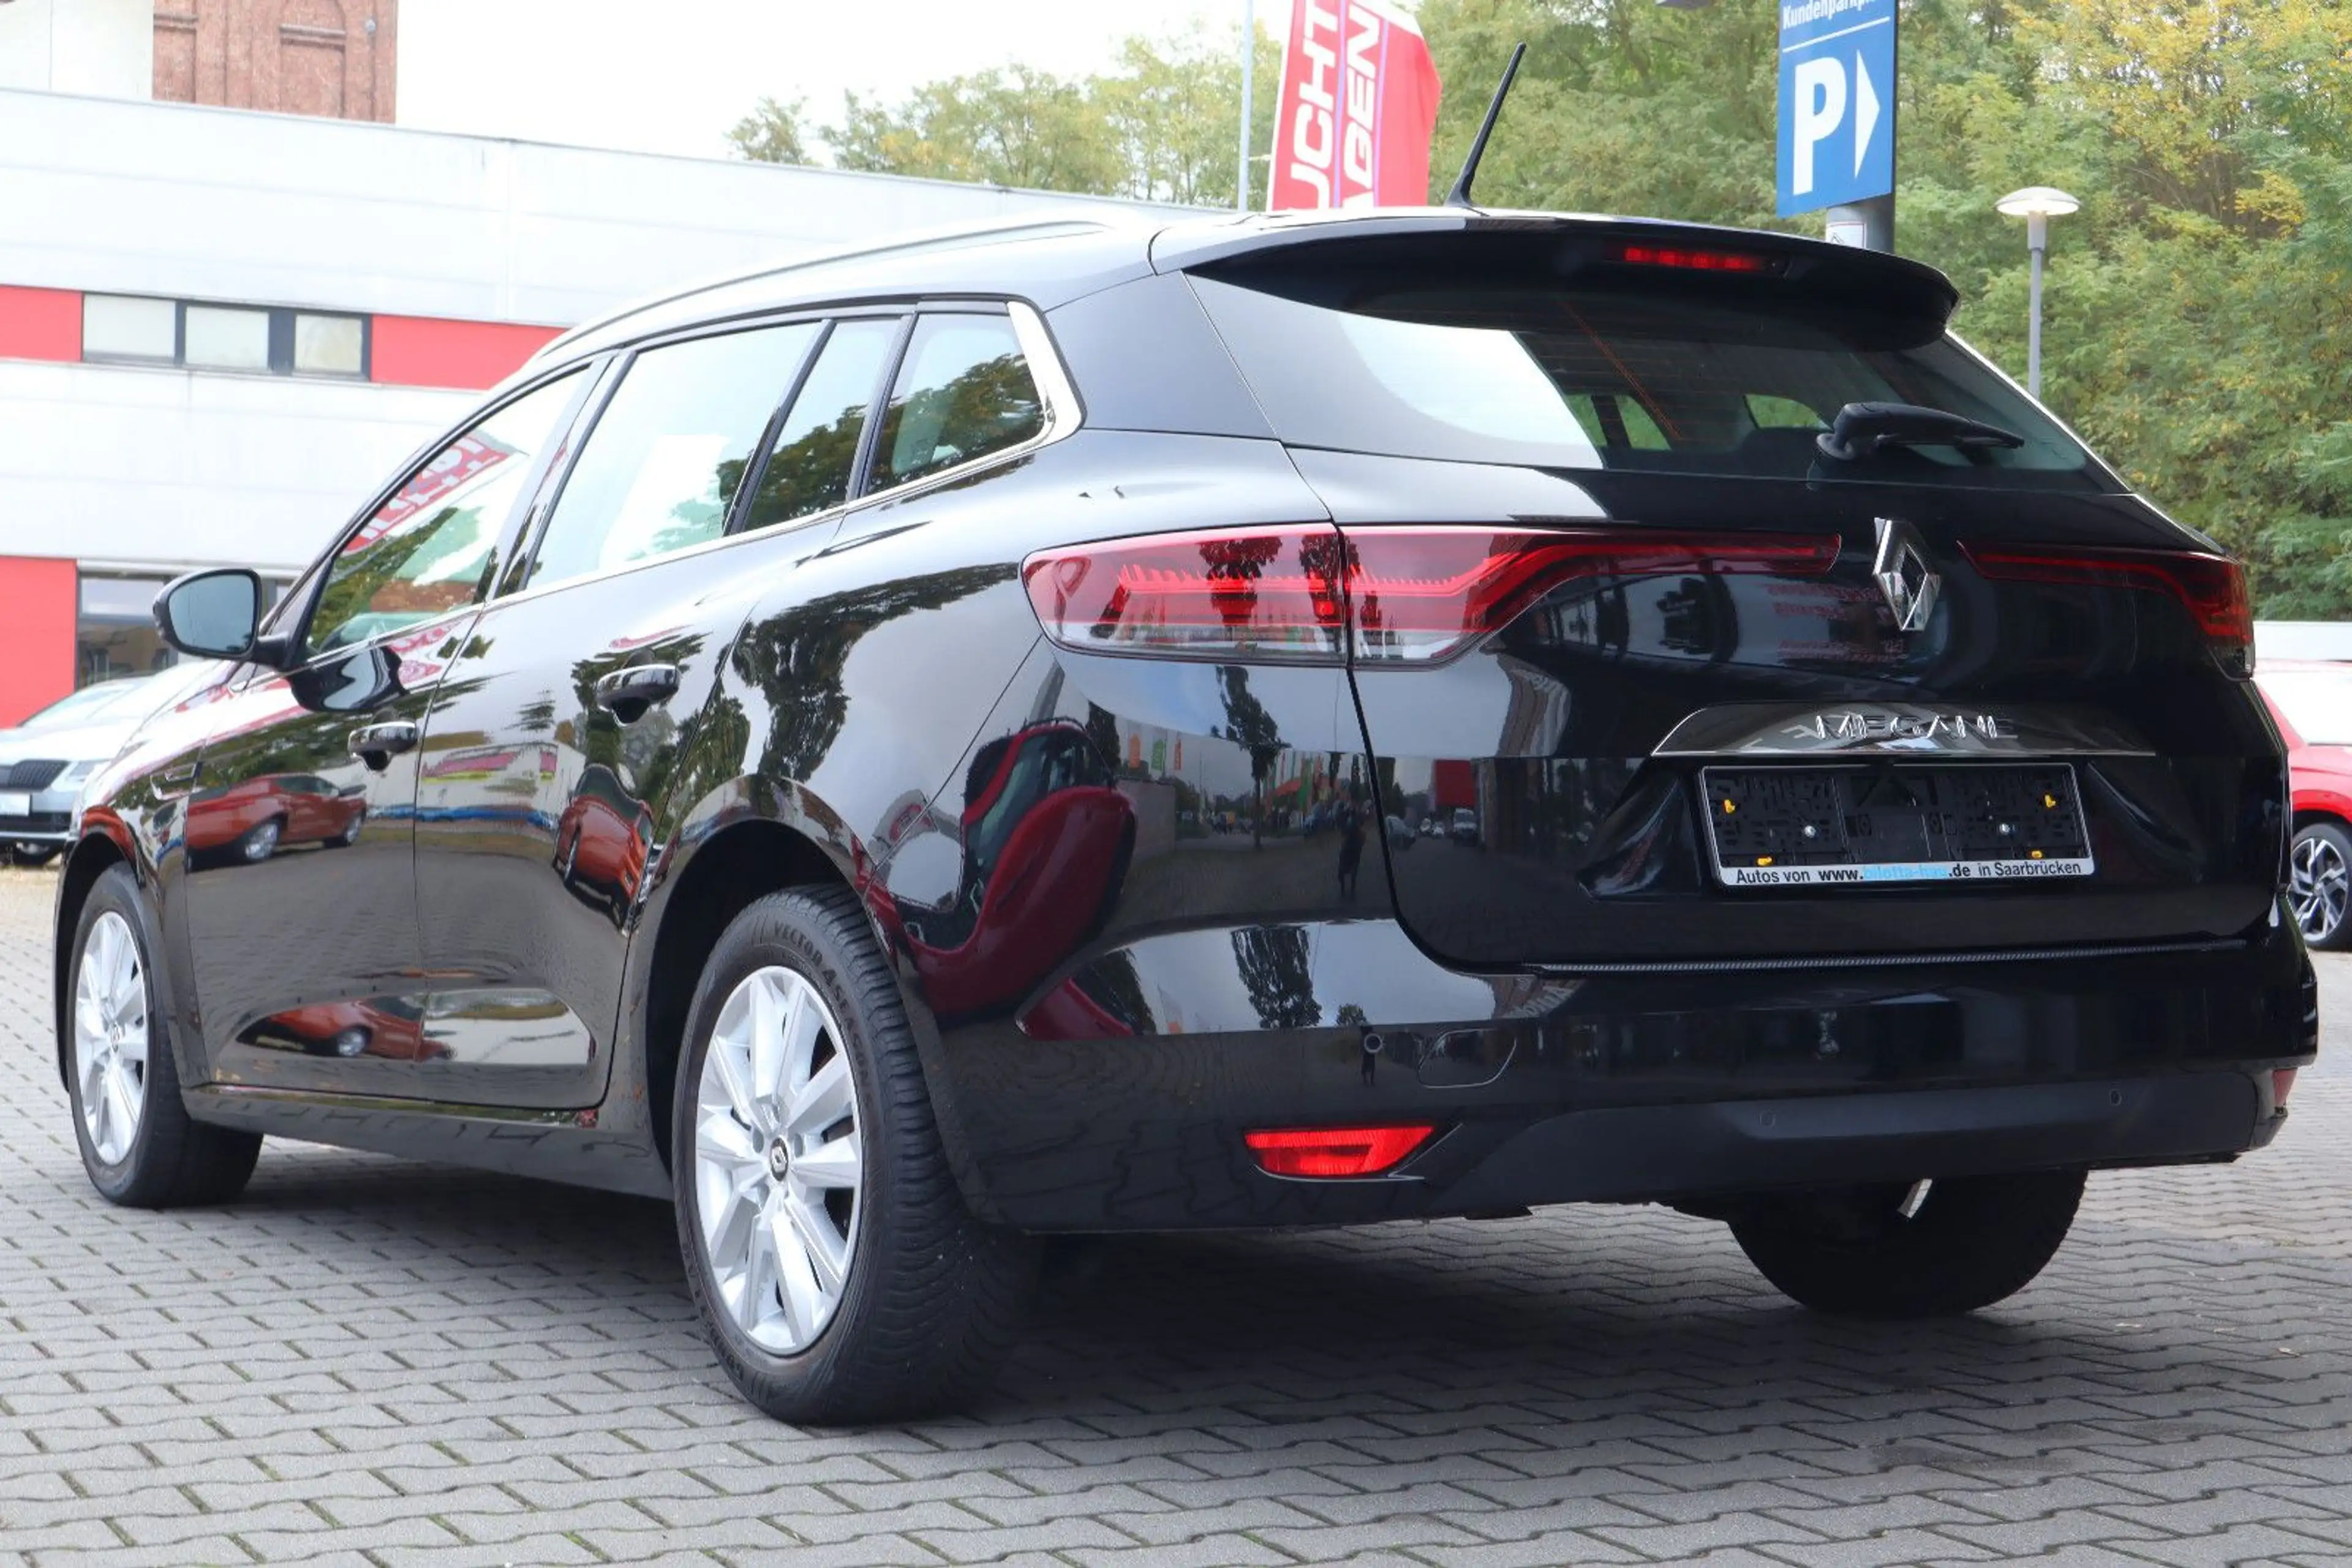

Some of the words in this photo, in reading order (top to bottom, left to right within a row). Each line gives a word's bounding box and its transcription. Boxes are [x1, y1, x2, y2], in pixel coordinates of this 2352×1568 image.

[1343, 4, 1380, 207] GEN
[1793, 57, 1847, 195] P
[1736, 869, 1780, 884] Autos
[1783, 870, 1811, 883] von
[1978, 863, 1991, 876] in
[1994, 861, 2081, 876] Saarbrücken
